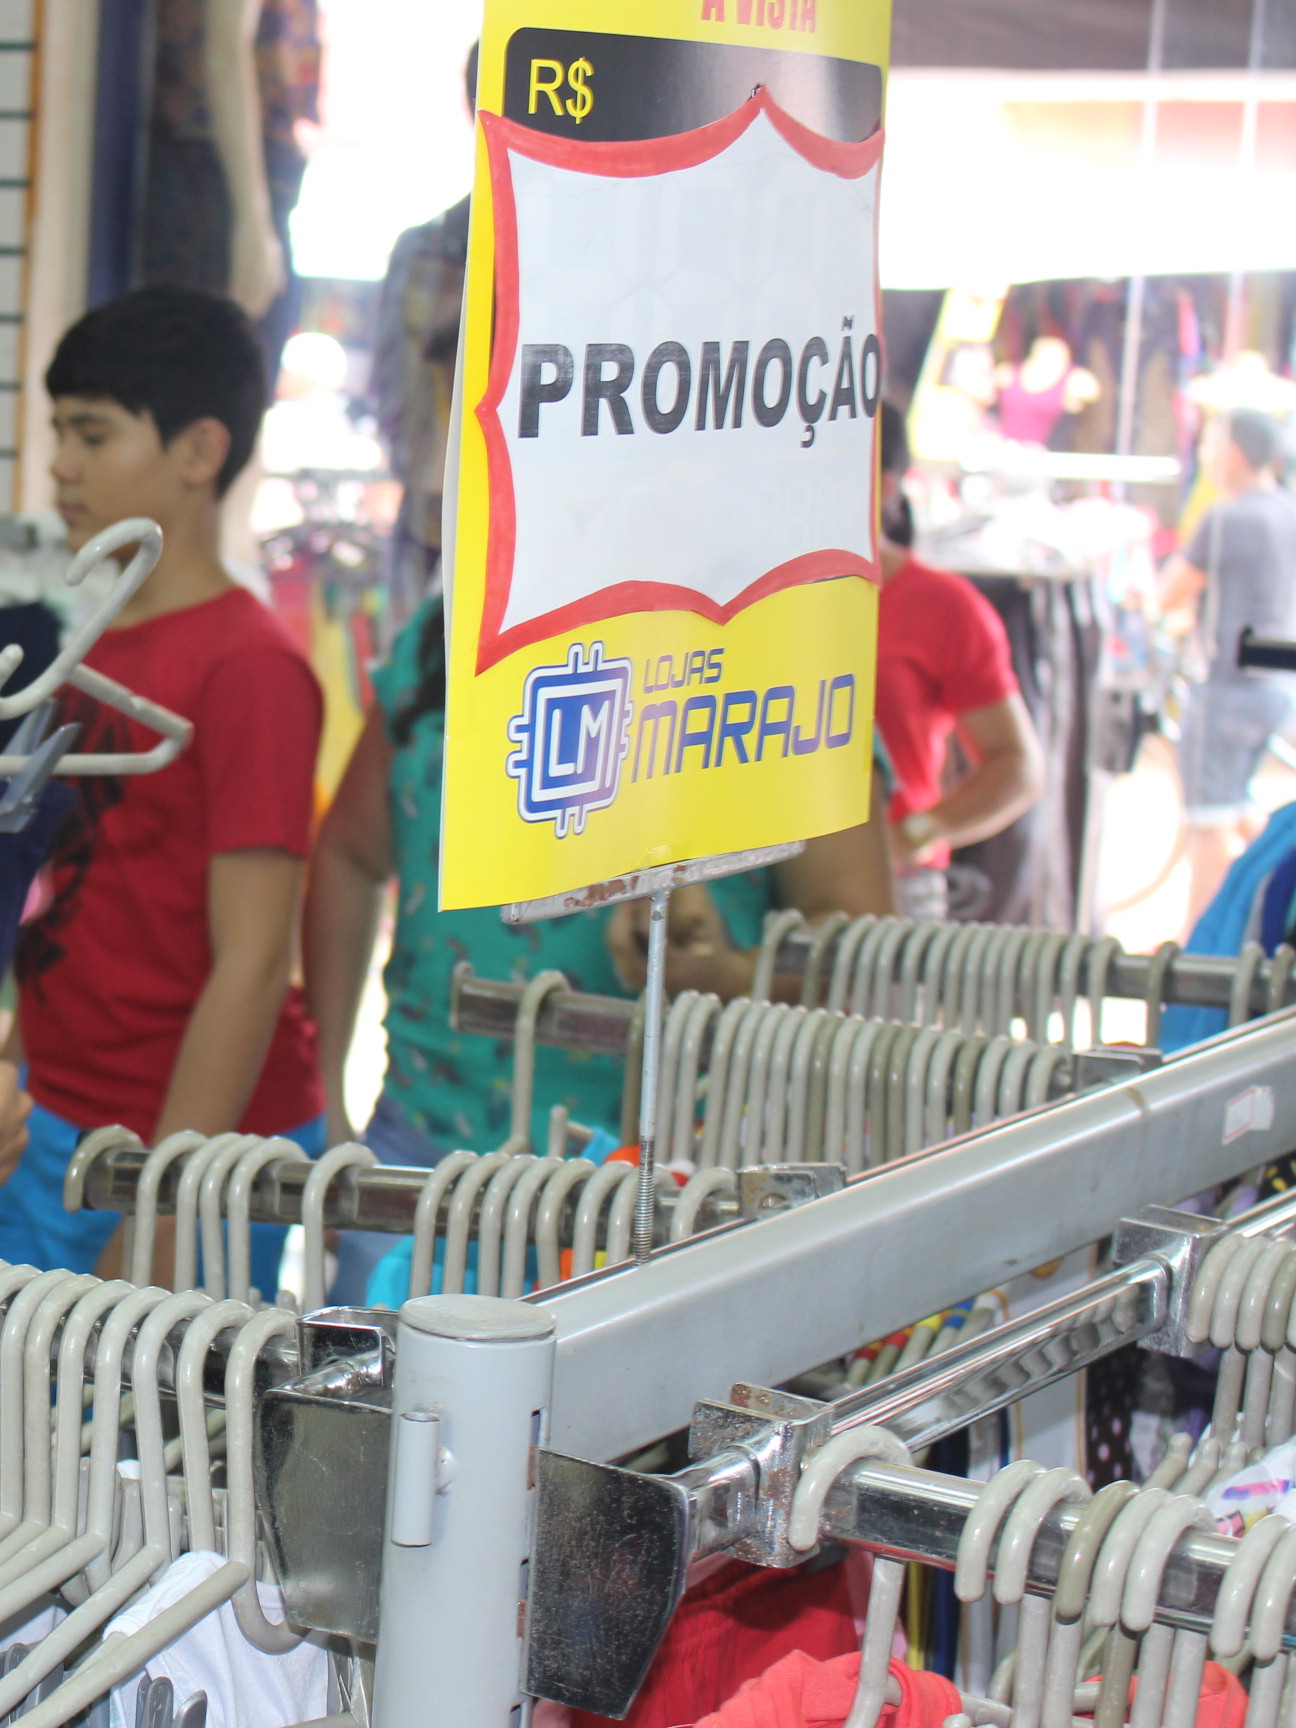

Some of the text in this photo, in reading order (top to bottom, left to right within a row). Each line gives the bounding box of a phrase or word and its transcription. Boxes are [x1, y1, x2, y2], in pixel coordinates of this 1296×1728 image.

[528, 57, 594, 124] R$
[517, 315, 881, 448] PROMOÇÃO
[643, 648, 725, 694] LOJAS
[631, 673, 855, 783] MARAJO
